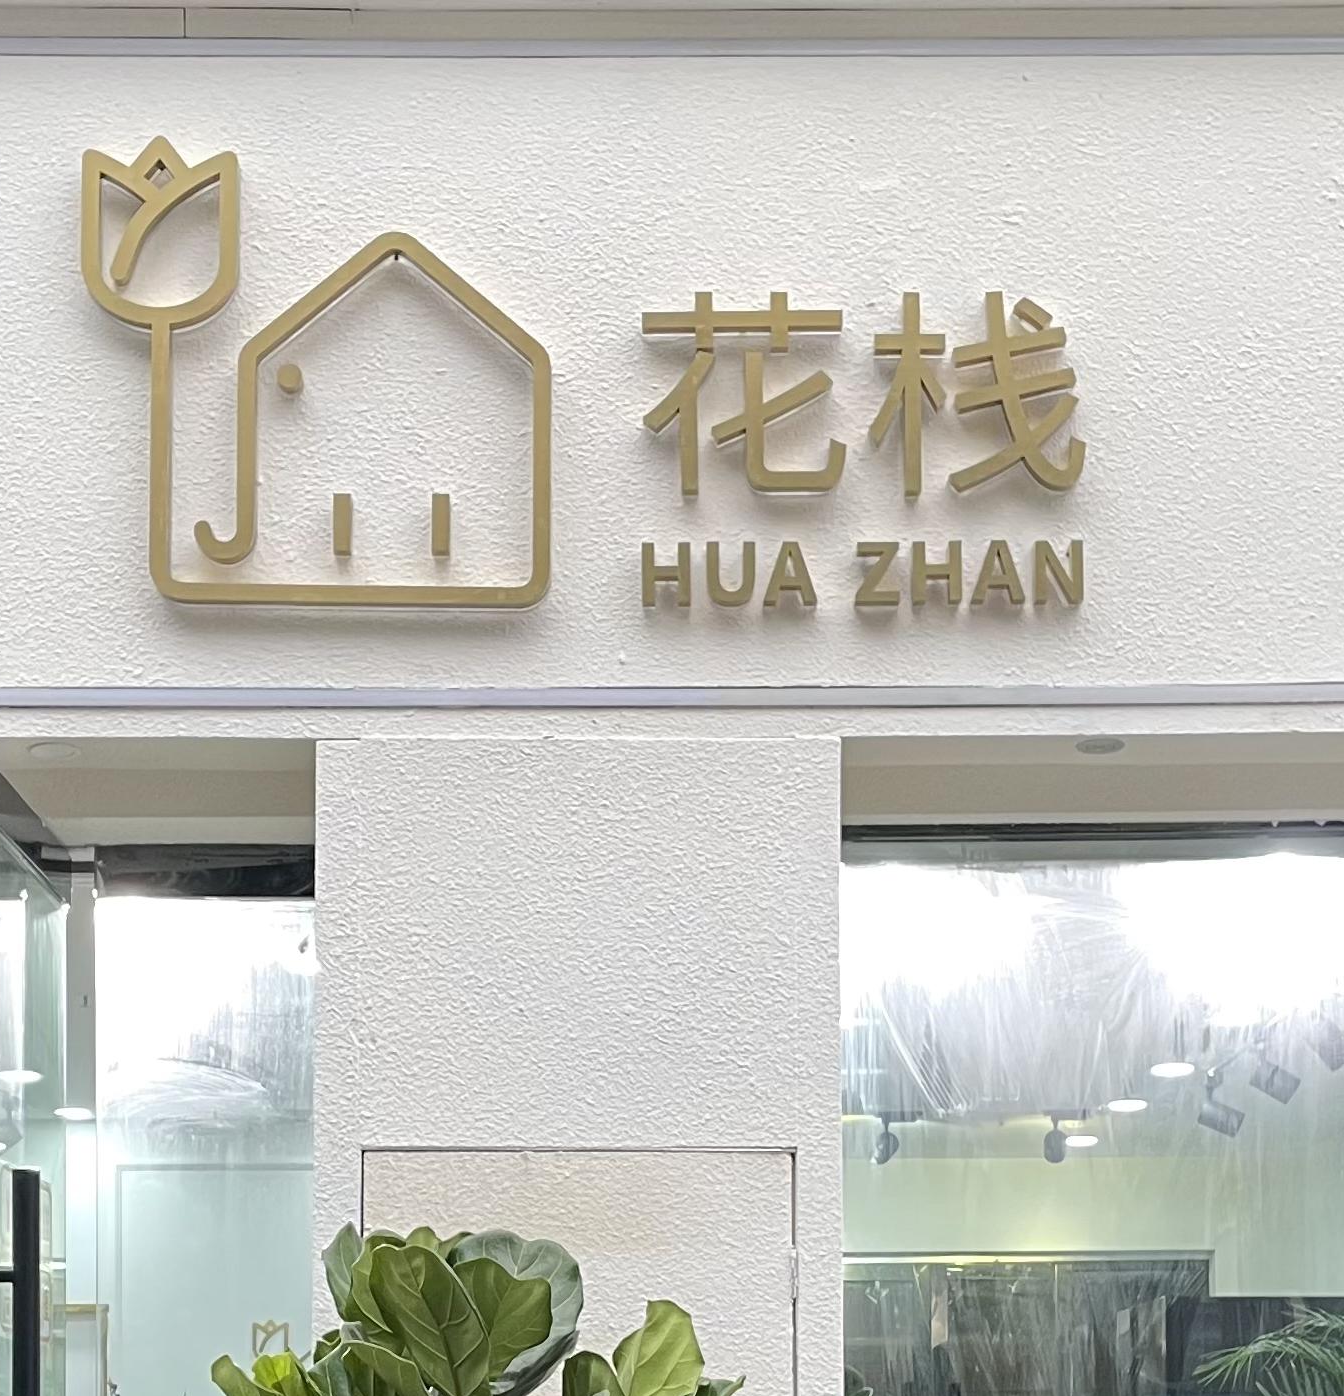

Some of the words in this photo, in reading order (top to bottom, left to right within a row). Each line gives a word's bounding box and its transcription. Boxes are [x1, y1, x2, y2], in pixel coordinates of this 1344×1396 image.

[641, 290, 1087, 496] 花栈
[641, 540, 817, 608] HUA
[855, 539, 1085, 607] ZHAN
